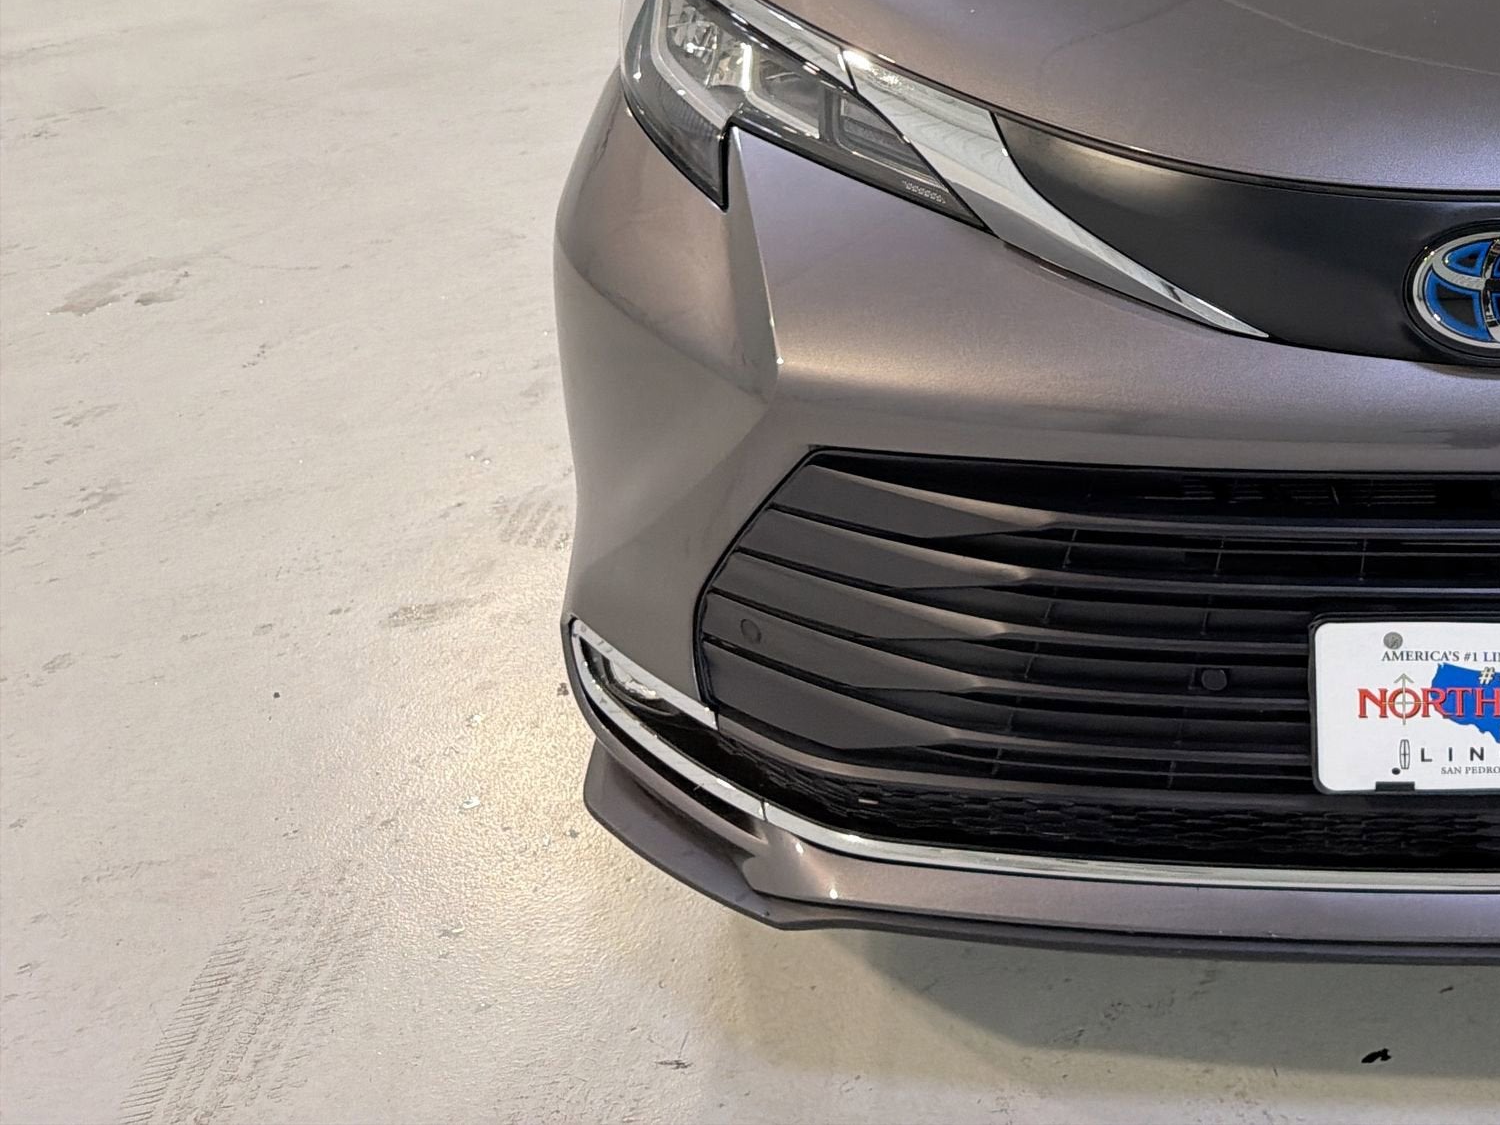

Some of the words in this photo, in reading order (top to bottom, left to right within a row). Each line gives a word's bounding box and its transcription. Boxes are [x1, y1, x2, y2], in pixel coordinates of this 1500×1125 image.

[1381, 650, 1460, 663] AMERICA'S
[1463, 650, 1477, 663] #1
[1440, 766, 1462, 775] SAN
[1465, 766, 1500, 775] PEDRO
